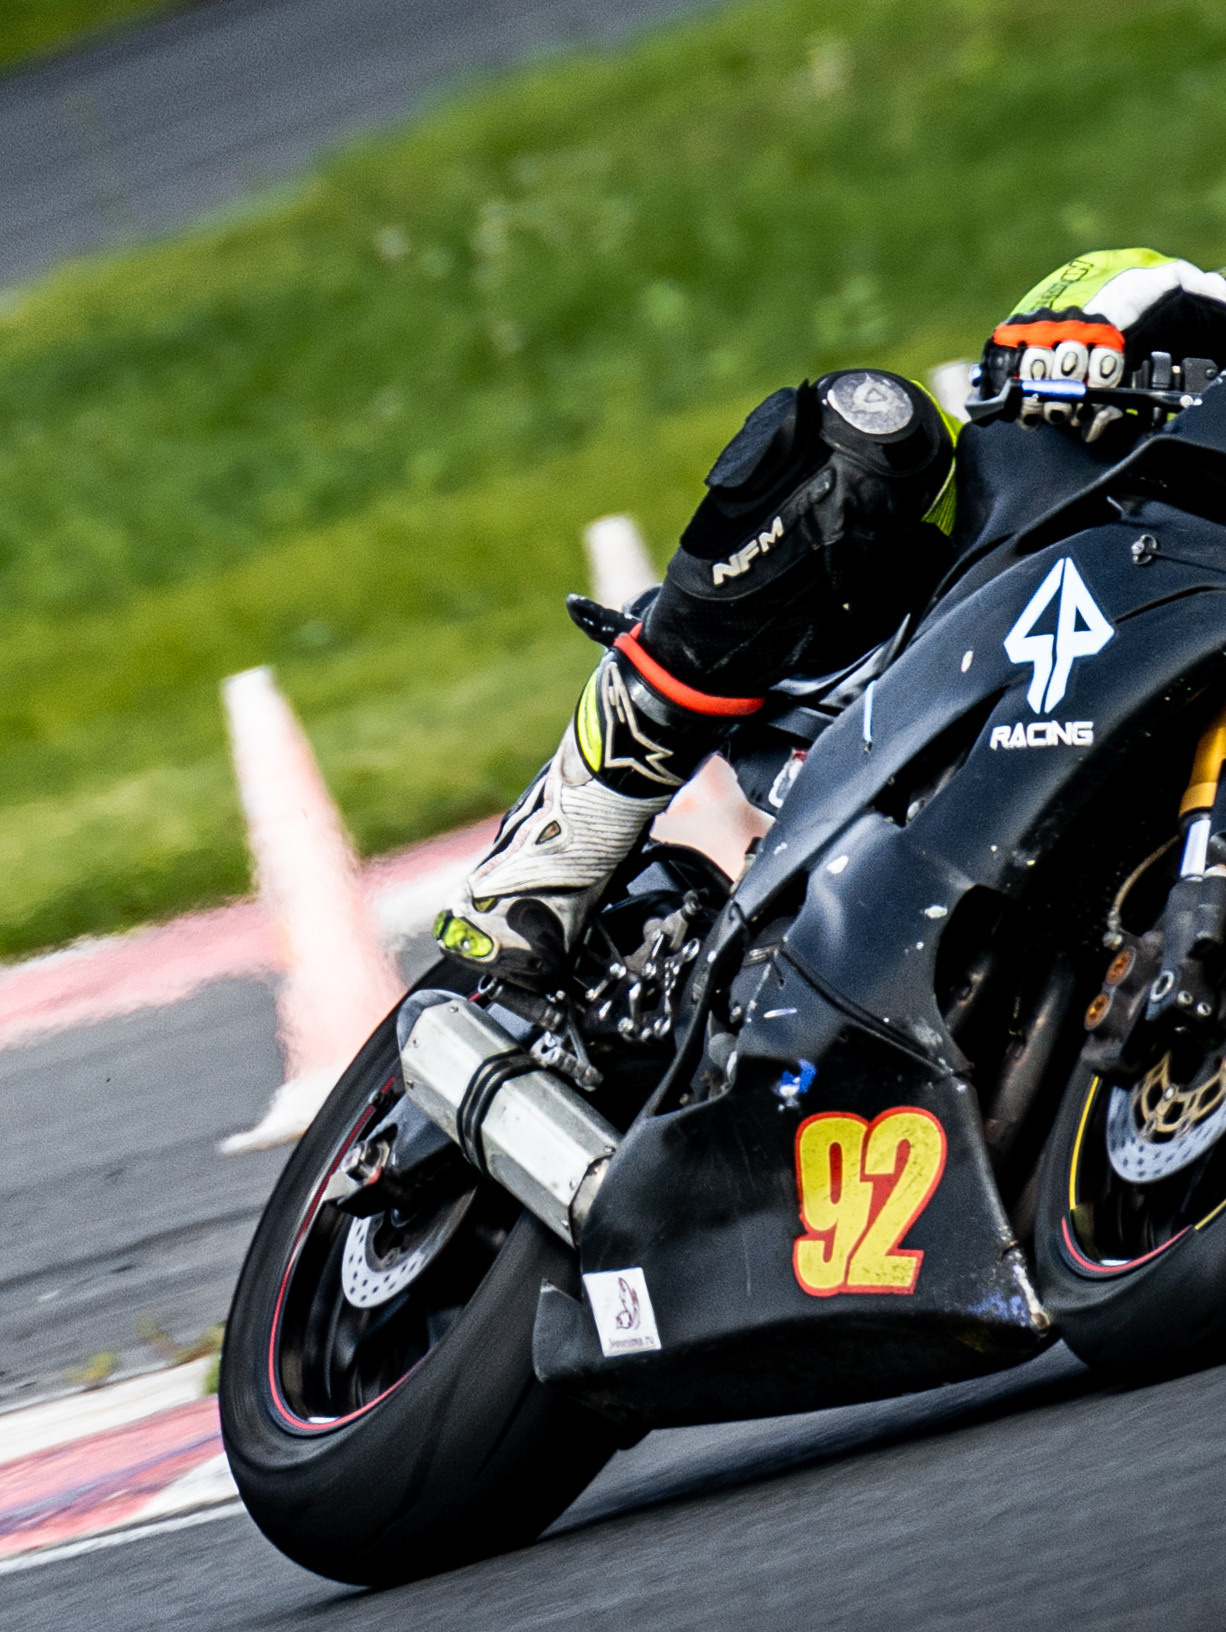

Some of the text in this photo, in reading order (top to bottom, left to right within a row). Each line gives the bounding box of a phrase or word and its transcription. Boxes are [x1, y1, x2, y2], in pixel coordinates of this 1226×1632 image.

[712, 516, 784, 585] NFM
[989, 720, 1094, 750] RACING
[793, 1106, 948, 1297] 92
